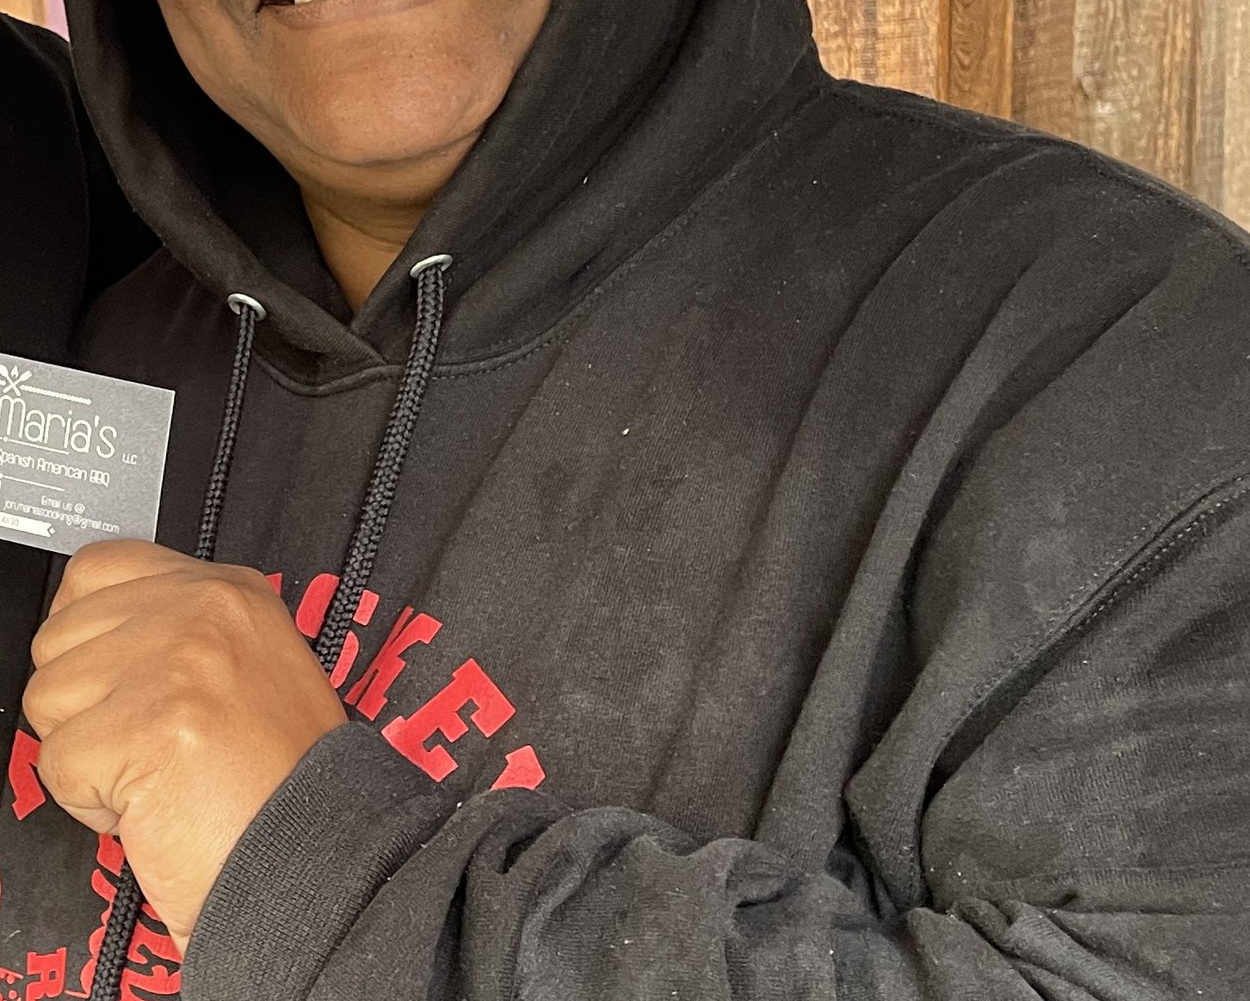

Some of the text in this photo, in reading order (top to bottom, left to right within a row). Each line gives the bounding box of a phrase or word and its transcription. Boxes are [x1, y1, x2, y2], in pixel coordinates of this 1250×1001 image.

[122, 452, 137, 464] LLC
[36, 457, 87, 480] American
[89, 469, 109, 487] BBQ
[40, 495, 61, 509] Email
[62, 502, 72, 511] us
